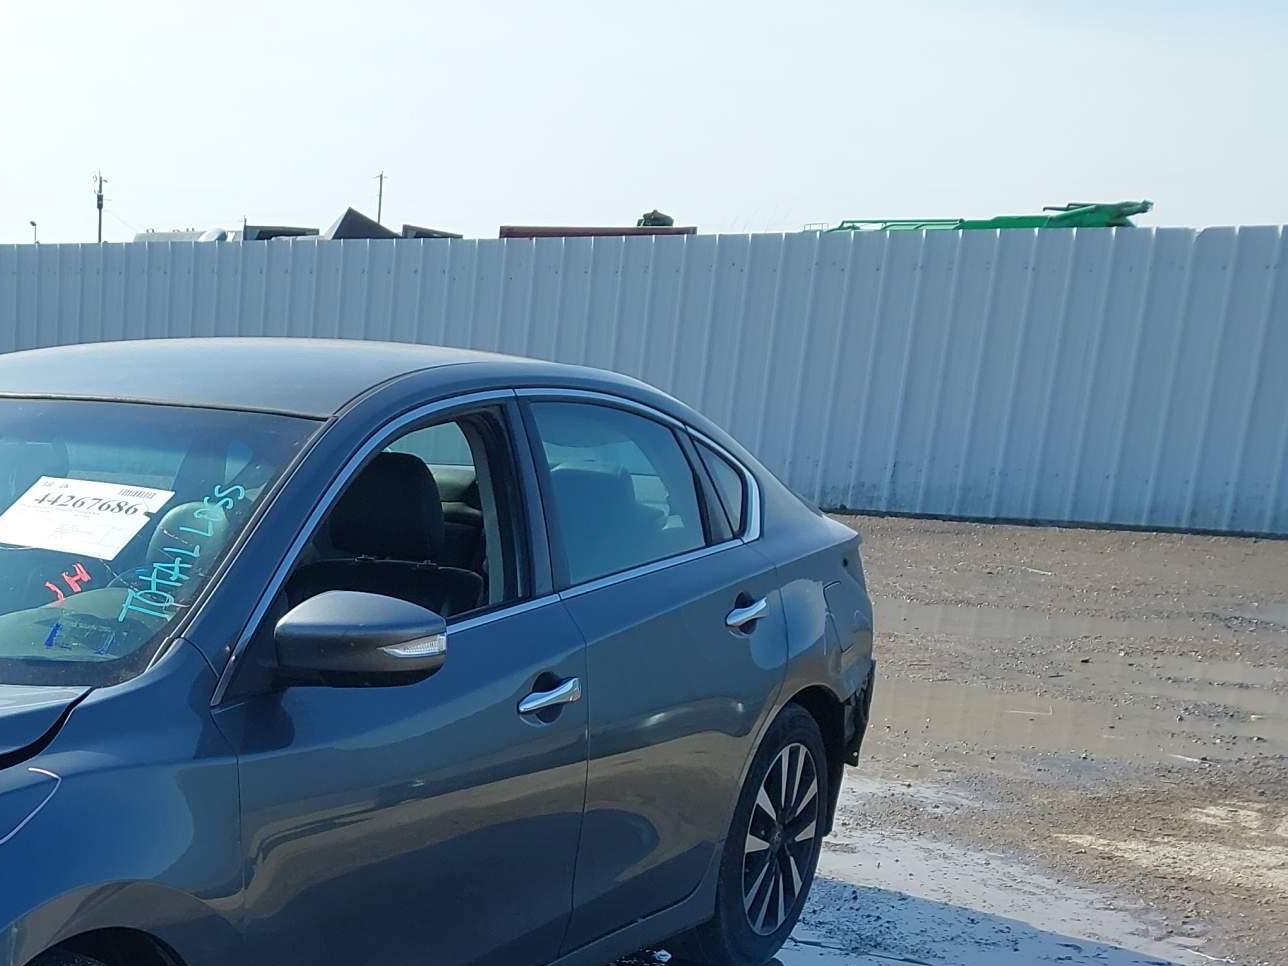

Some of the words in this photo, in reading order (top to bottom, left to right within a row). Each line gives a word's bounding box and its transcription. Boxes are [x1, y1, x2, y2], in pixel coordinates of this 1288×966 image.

[34, 492, 143, 516] 44267686
[118, 544, 200, 622] TOTAL
[179, 484, 245, 537] LOSS
